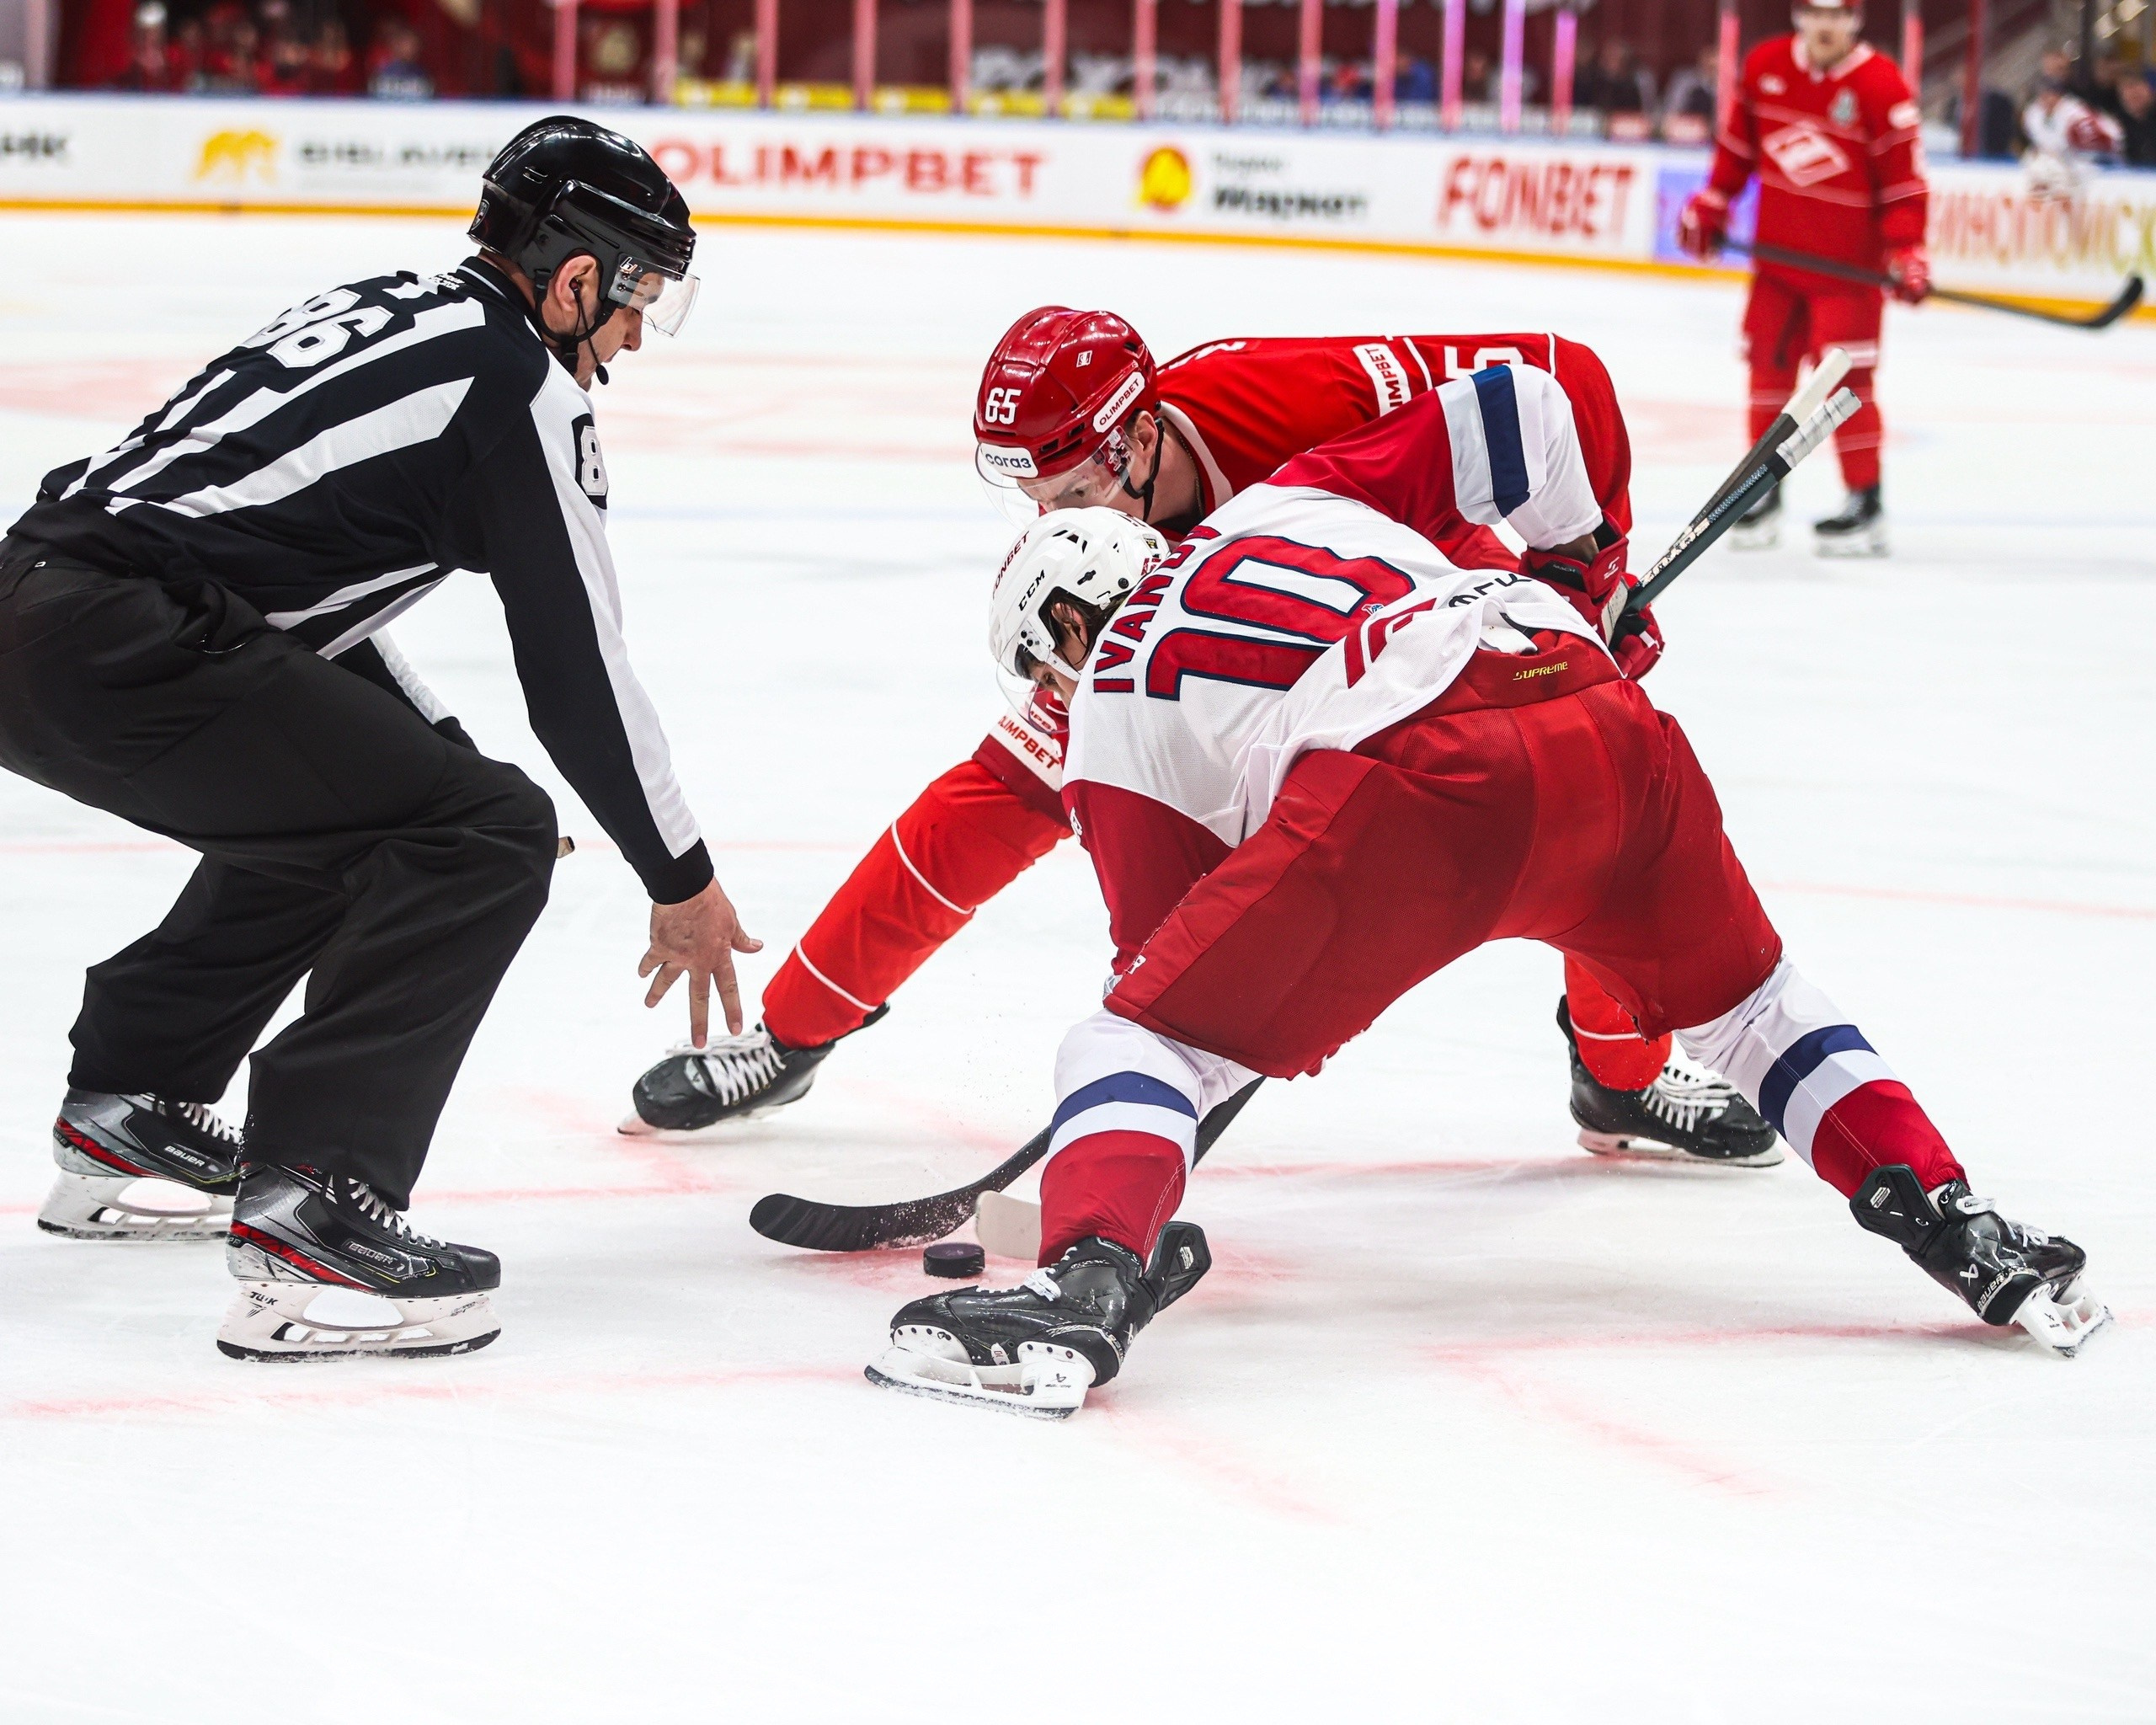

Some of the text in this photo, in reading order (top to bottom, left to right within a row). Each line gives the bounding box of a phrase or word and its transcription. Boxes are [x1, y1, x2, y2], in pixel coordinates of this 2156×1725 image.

[652, 140, 1043, 199] OLIMPBET
[1437, 155, 1634, 238] FONBET
[242, 288, 395, 368] 86
[985, 387, 1022, 425] 65
[1099, 378, 1139, 426] OLIMPBET
[1364, 348, 1403, 409] IMPBET
[993, 531, 1030, 595] ONBET
[1017, 569, 1045, 611] CCM
[1145, 534, 1417, 702] 10
[1513, 660, 1568, 681] SUPREME
